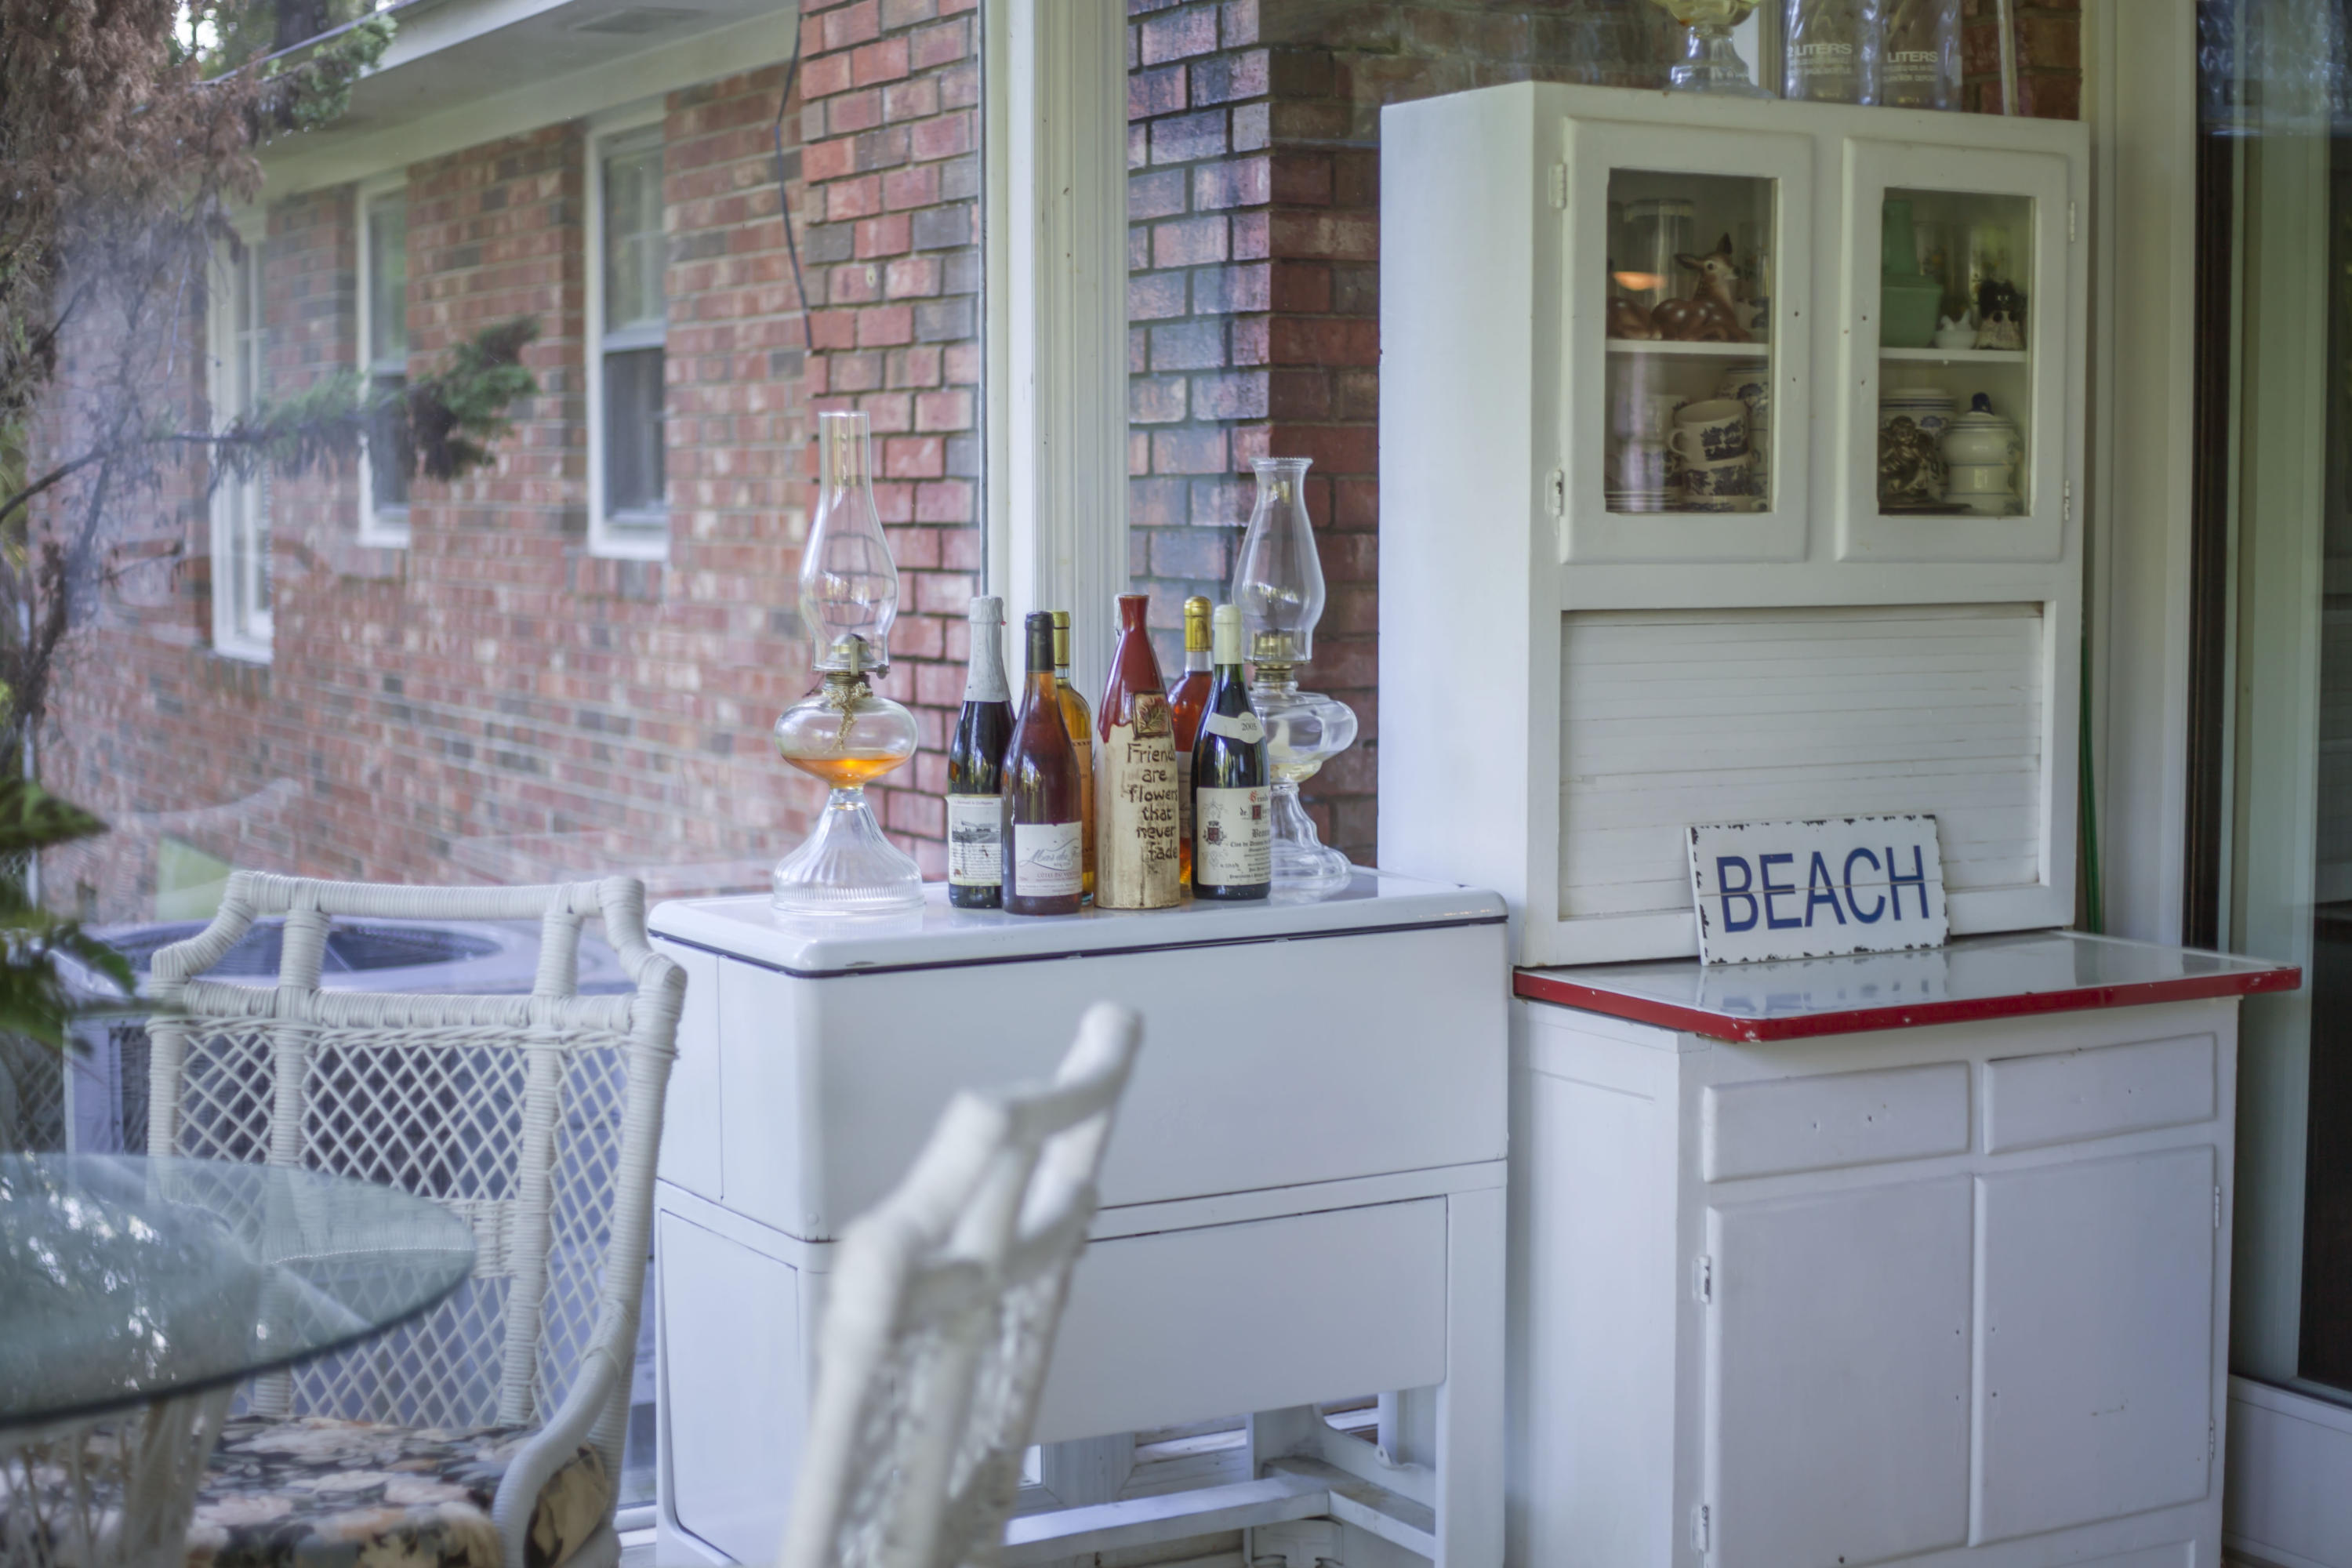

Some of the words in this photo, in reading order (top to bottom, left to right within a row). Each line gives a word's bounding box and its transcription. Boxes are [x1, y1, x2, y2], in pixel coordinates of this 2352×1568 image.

[1795, 43, 1852, 56] LITERS
[1887, 51, 1938, 63] LITERS
[1142, 769, 1167, 783] are
[1142, 804, 1173, 822] that
[1136, 826, 1176, 839] never
[1148, 840, 1178, 862] fade
[1716, 845, 1929, 933] BEACH
